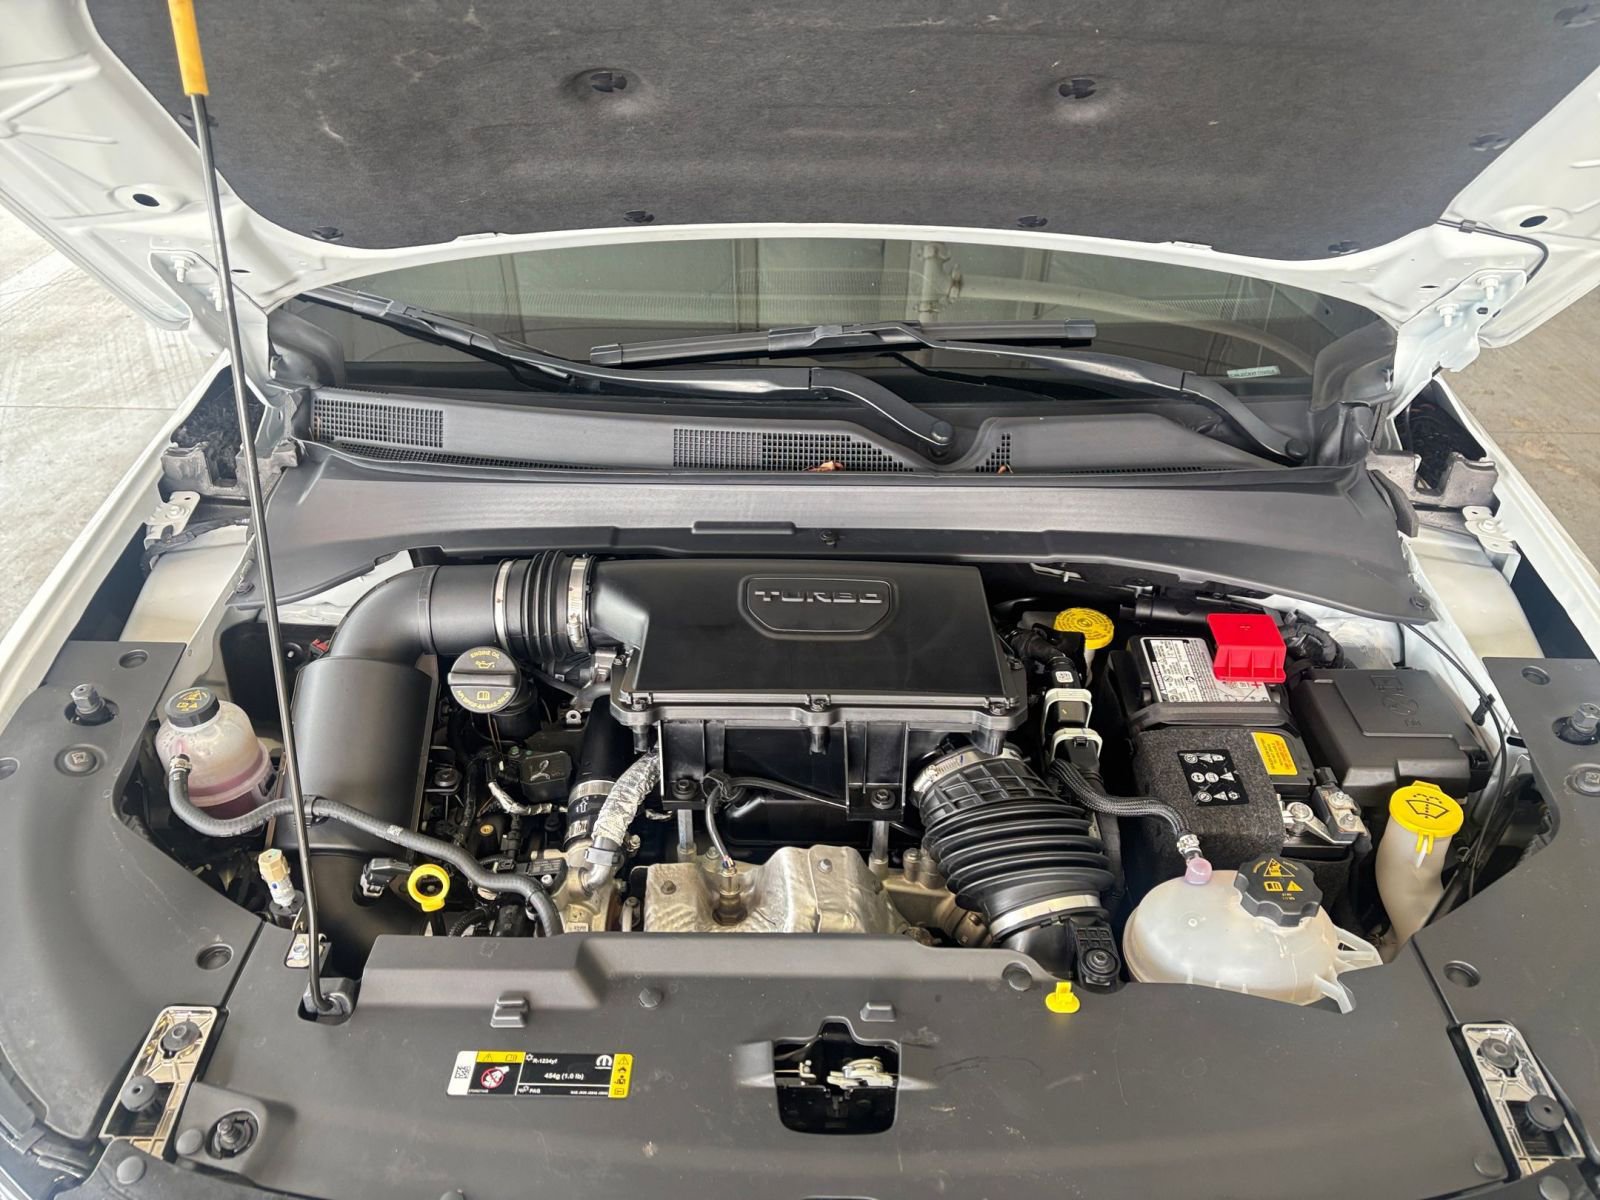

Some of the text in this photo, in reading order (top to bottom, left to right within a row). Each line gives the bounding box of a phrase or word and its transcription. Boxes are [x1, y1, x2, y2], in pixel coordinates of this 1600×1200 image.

[754, 590, 883, 604] TURBO
[470, 650, 500, 659] ENGINE OIL
[532, 1057, 558, 1065] R-1234yf
[544, 1072, 561, 1080] 454g
